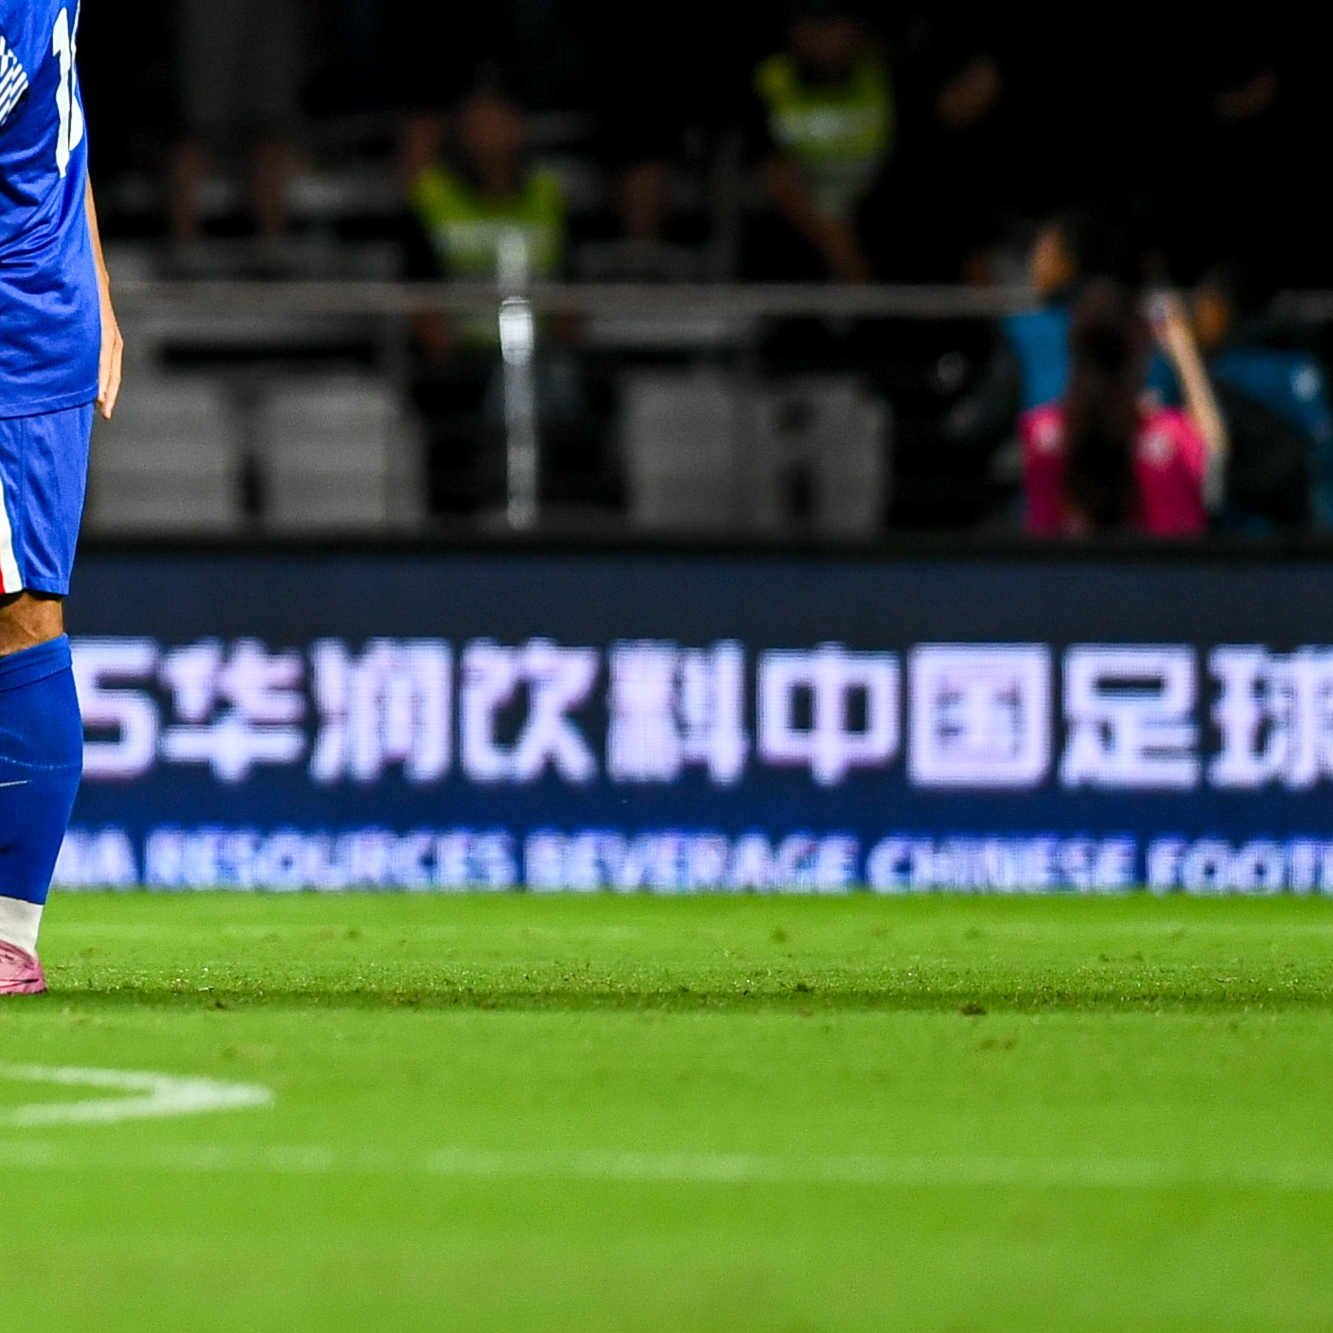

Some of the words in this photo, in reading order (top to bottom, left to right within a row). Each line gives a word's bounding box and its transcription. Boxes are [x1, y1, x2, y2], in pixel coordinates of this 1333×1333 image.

[144, 826, 517, 891] RESOURCES
[524, 827, 860, 893] BEVERAGE
[866, 829, 1137, 894] CHINESE
[1145, 832, 1333, 895] FOOT
